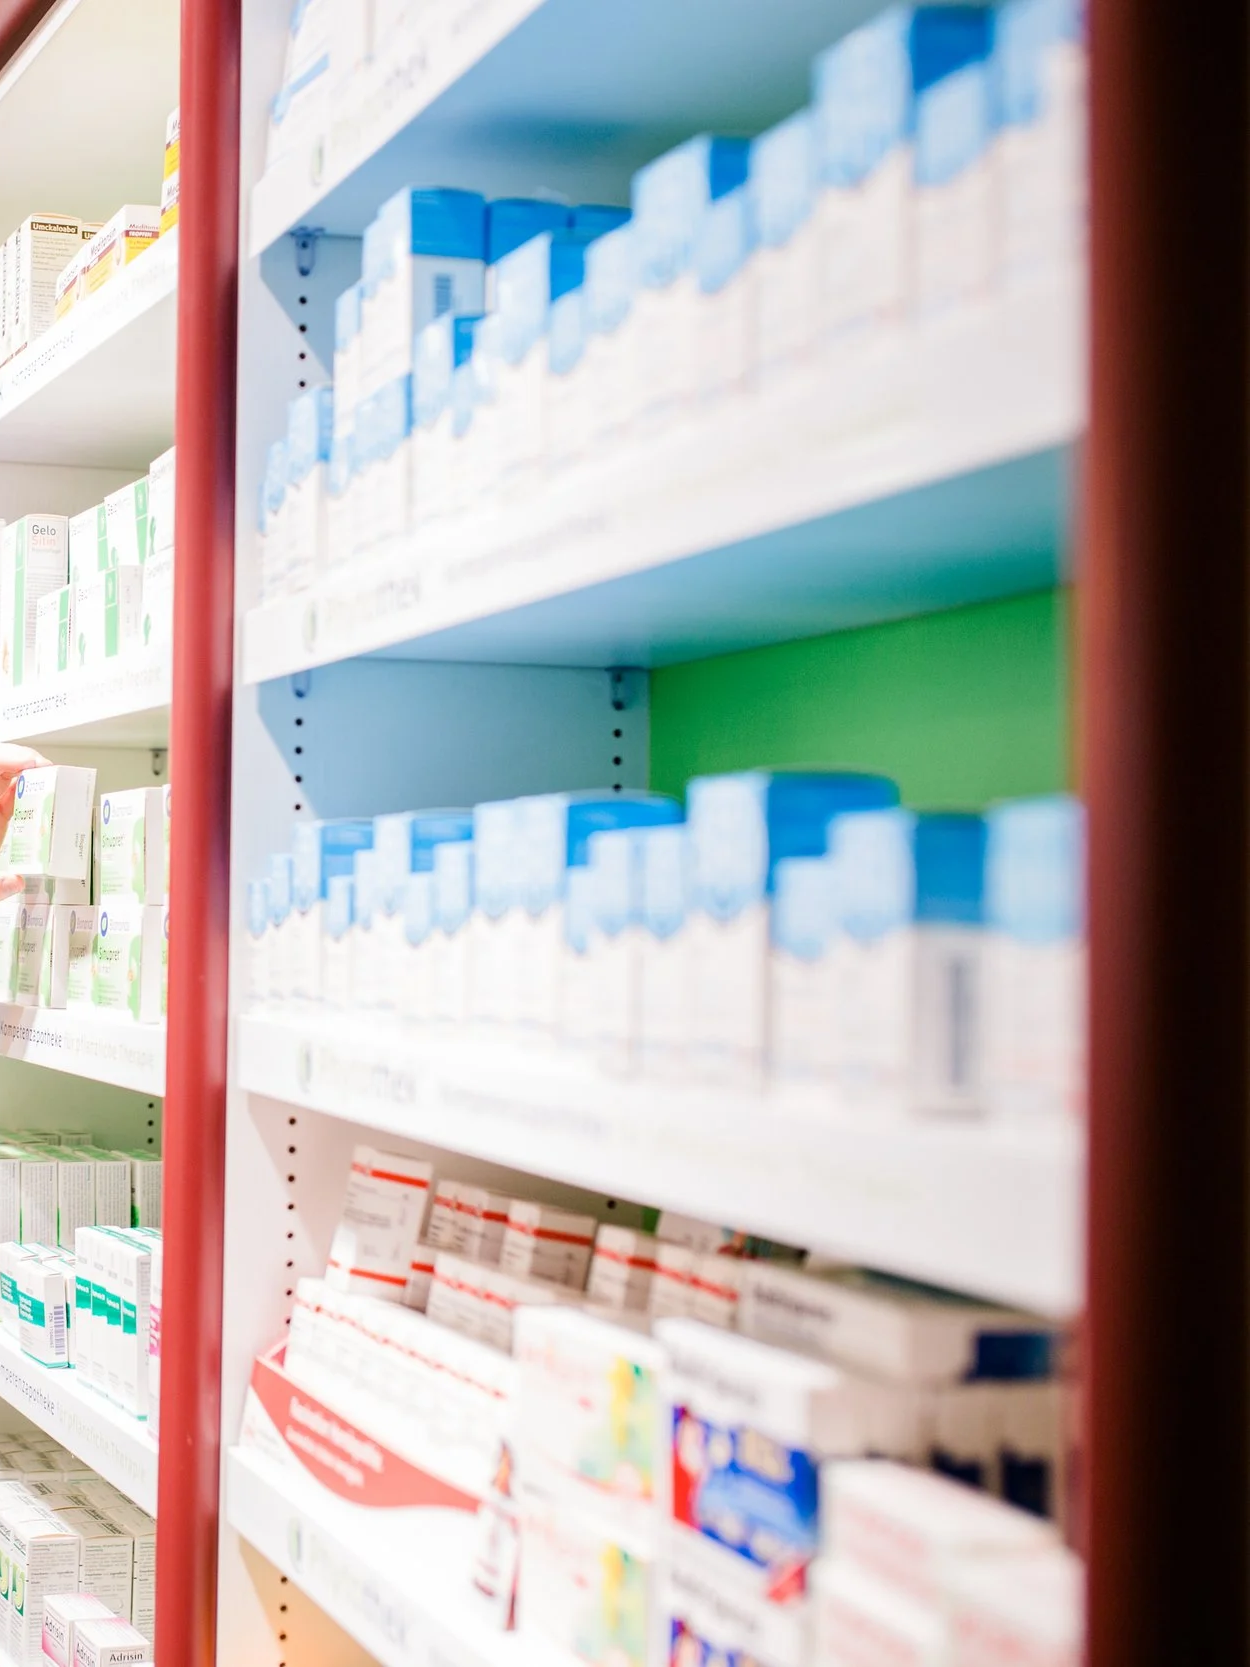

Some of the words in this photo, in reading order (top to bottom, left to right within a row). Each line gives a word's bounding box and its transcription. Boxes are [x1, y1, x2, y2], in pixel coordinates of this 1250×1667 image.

[32, 223, 76, 233] Umckaloabo
[32, 524, 56, 536] Gelo
[109, 1651, 143, 1662] Adrisin
